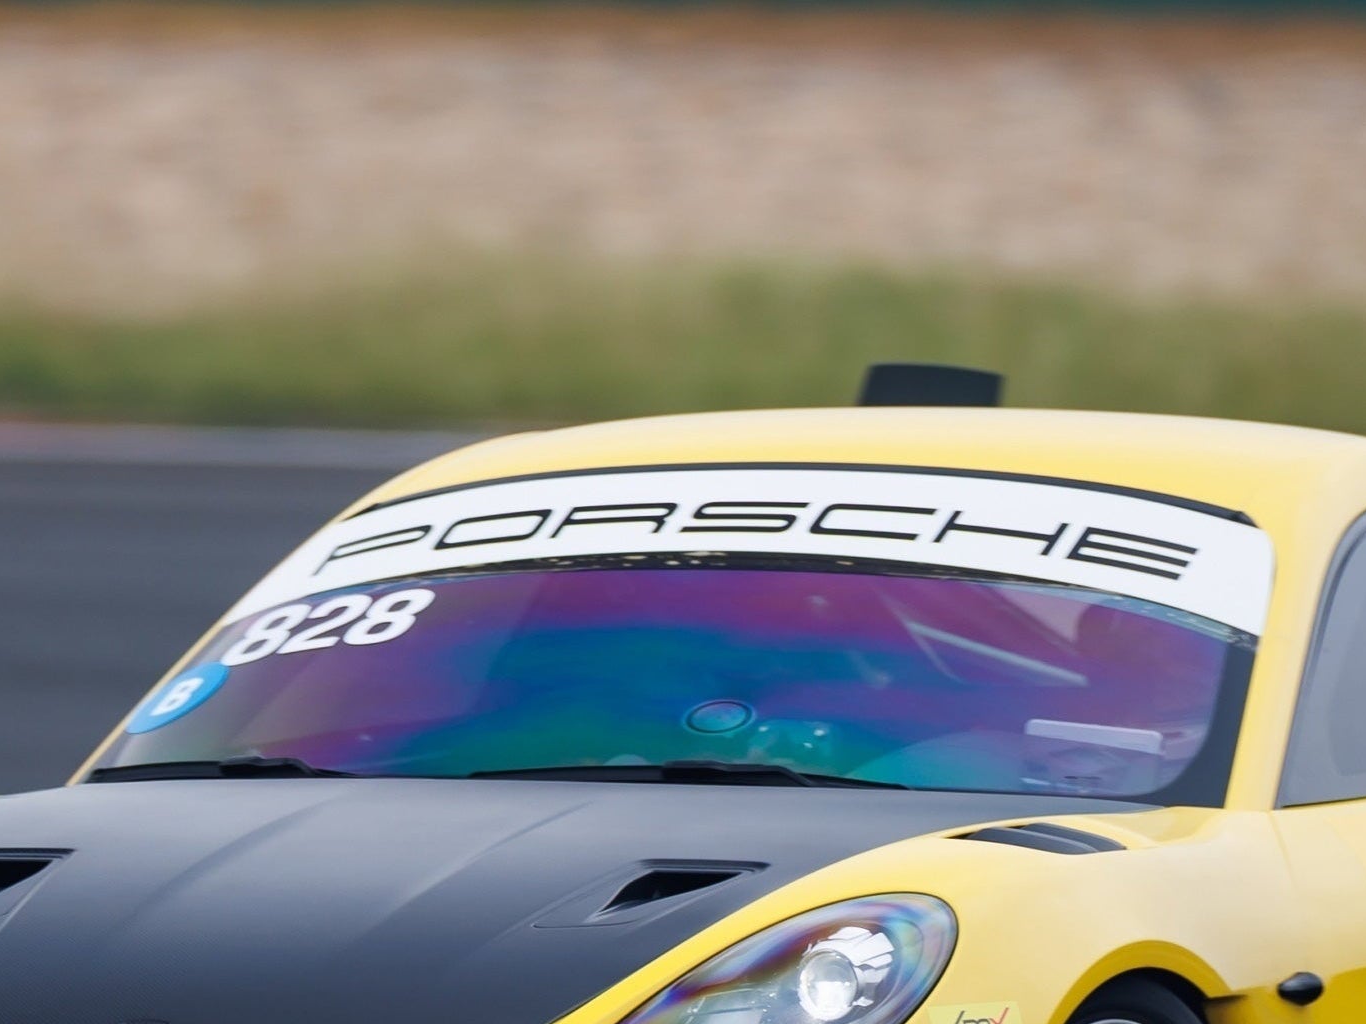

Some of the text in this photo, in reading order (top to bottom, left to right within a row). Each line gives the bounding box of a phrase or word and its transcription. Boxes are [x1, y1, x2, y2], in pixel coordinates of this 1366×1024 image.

[311, 500, 1198, 581] PORSCHE
[220, 588, 436, 667] 828
[149, 677, 205, 716] B
